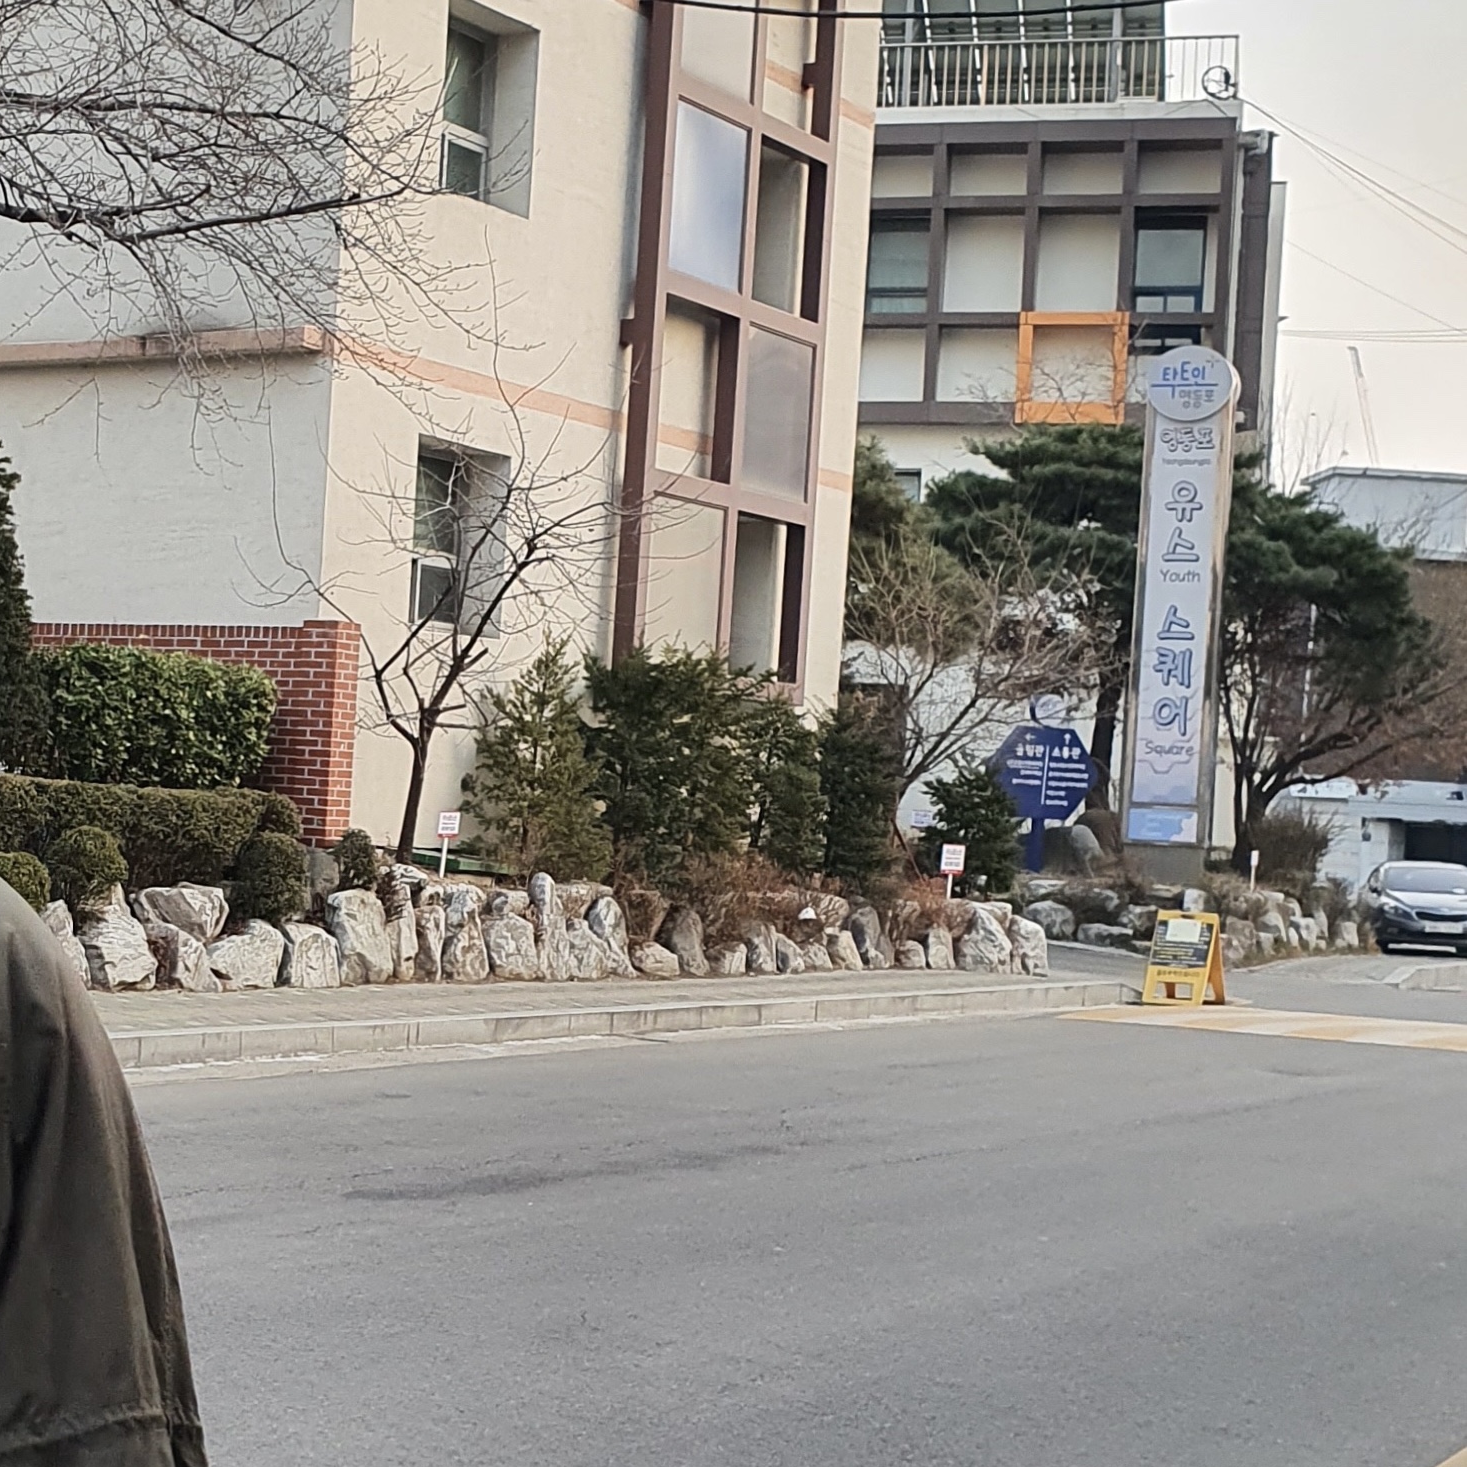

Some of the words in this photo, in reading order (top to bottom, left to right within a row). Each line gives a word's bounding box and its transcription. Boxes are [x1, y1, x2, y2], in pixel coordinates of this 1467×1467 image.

[1178, 388, 1215, 409] 영등포
[1160, 427, 1215, 453] 영등포
[1161, 480, 1203, 563] 유스
[1159, 569, 1201, 583] Youth
[1153, 604, 1195, 737] 스퀘어
[1144, 741, 1194, 757] Square
